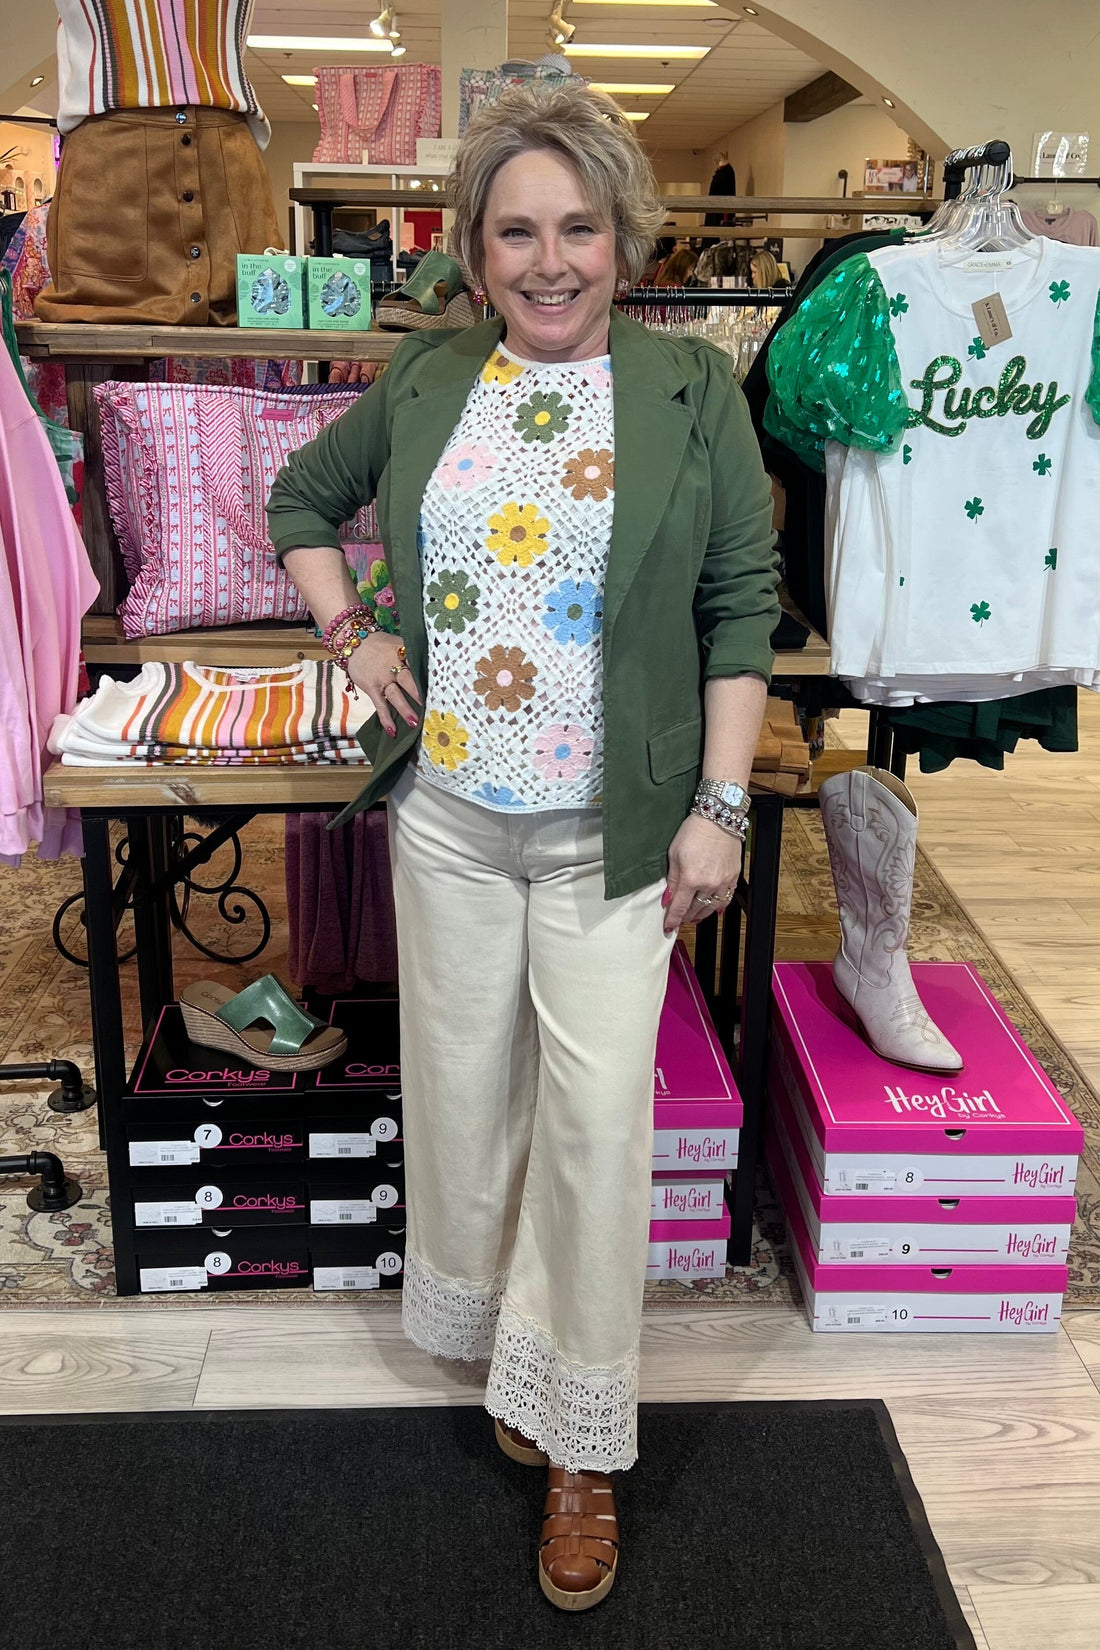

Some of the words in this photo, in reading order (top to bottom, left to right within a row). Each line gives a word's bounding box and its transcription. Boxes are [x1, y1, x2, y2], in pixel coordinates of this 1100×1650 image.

[241, 262, 249, 270] in
[250, 261, 262, 270] the
[320, 265, 333, 273] the
[312, 272, 328, 280] buff
[905, 355, 1071, 440] Lucky
[165, 1067, 271, 1083] Corkys
[344, 1062, 401, 1076] Cor
[203, 1129, 213, 1141] 7
[378, 1123, 388, 1135] 9
[229, 1131, 294, 1148] Corkys
[905, 1171, 915, 1184] 8
[204, 1191, 213, 1203] 8
[233, 1193, 297, 1210] Corkys
[379, 1189, 388, 1202] 9
[900, 1243, 912, 1256] 9
[213, 1256, 223, 1268] 8
[237, 1259, 300, 1275] Corkys
[380, 1256, 397, 1269] 10
[891, 1308, 909, 1321] 10
